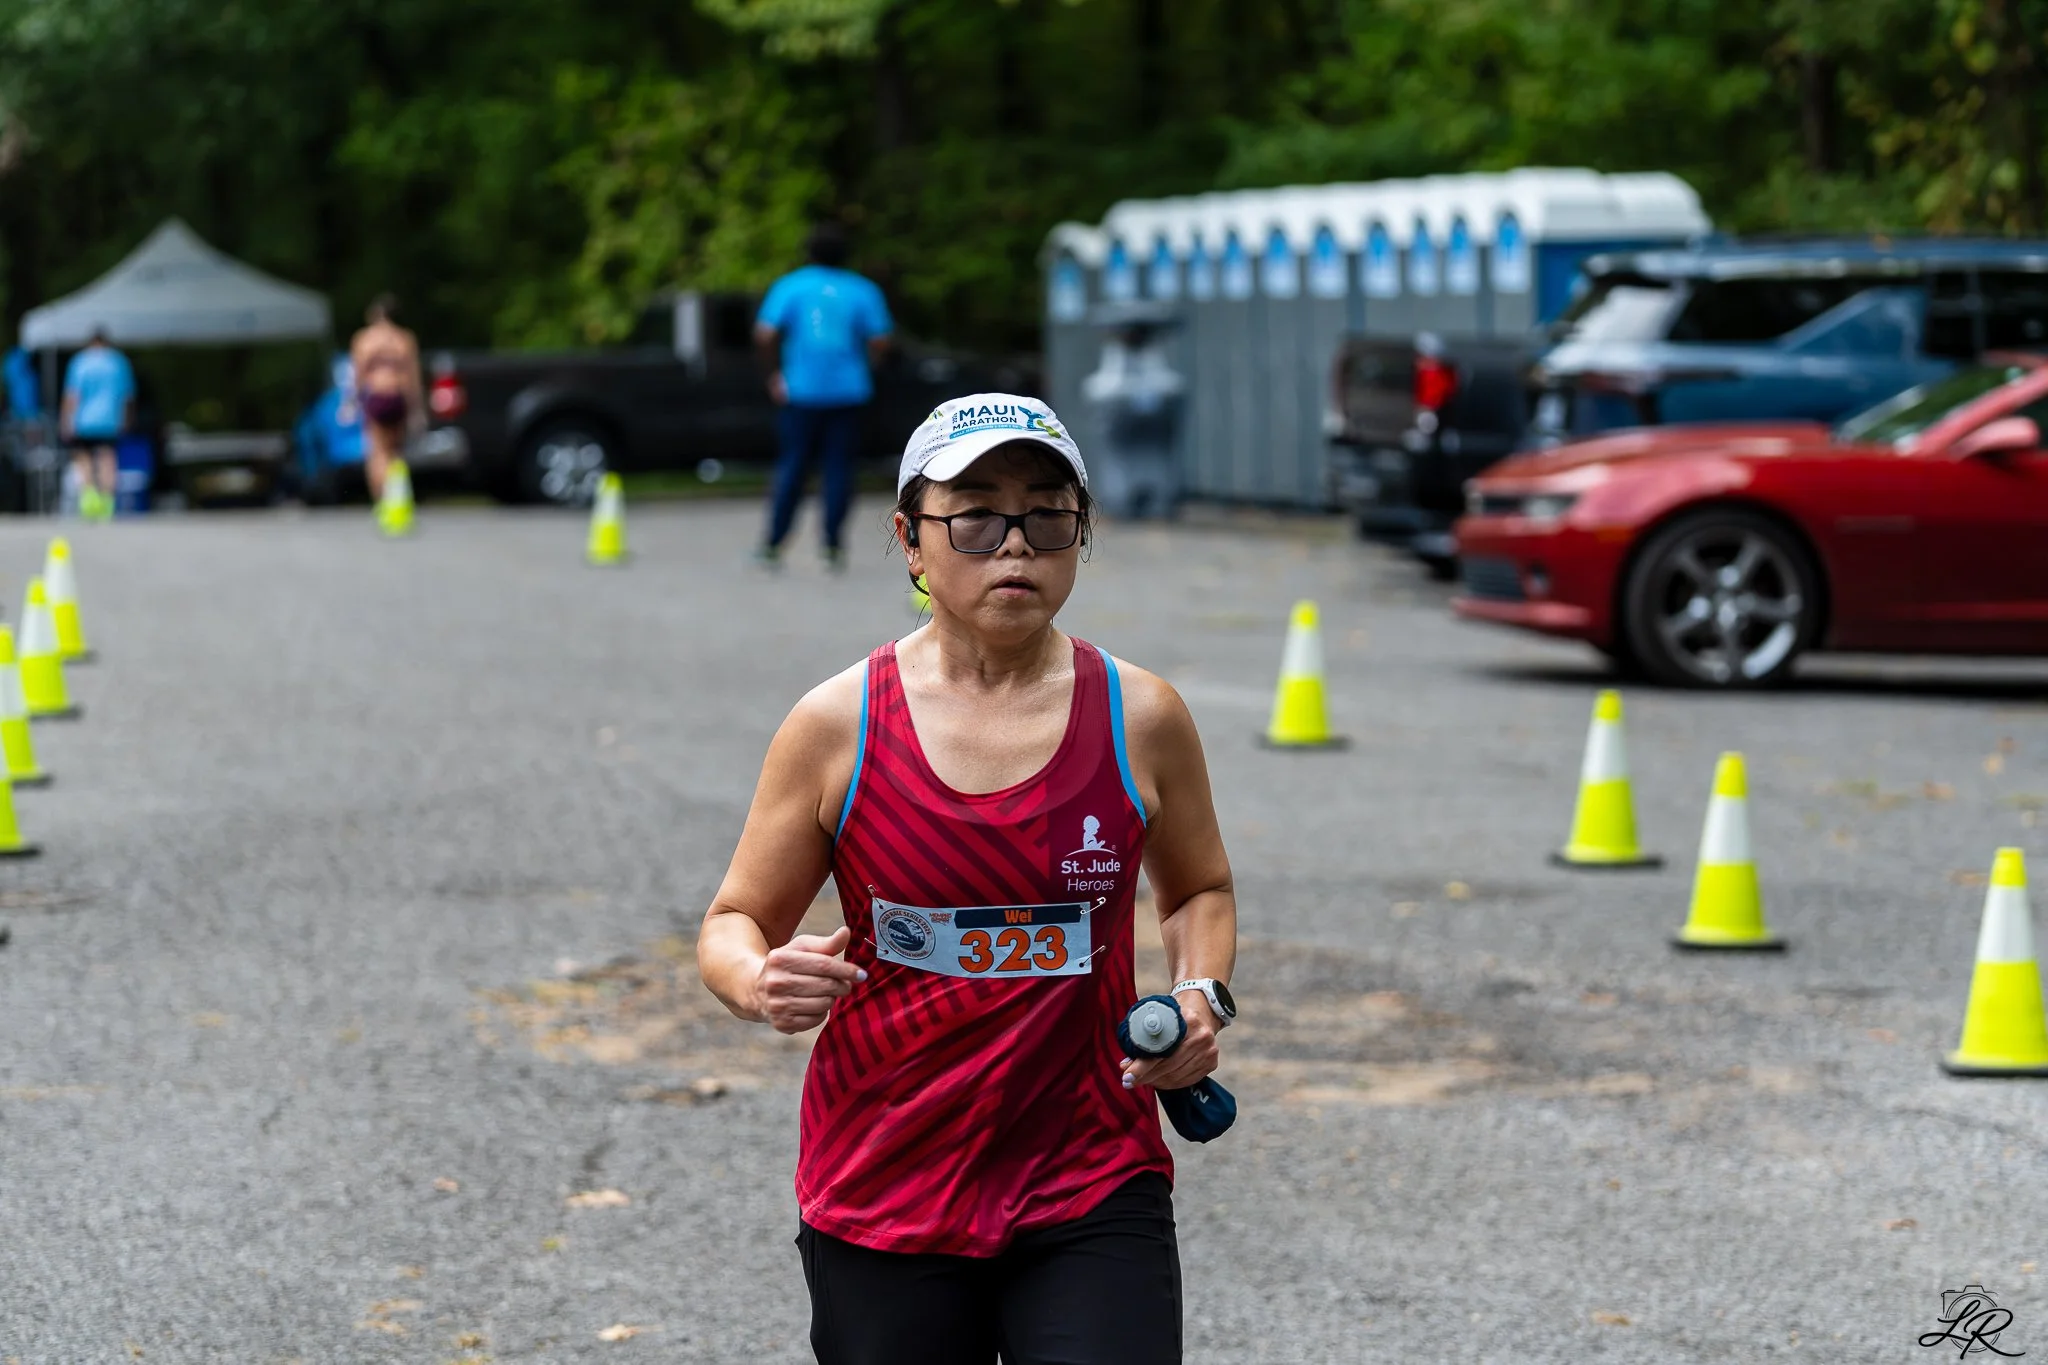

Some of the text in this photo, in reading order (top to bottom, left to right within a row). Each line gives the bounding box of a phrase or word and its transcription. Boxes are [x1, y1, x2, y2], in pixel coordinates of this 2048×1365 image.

[959, 405, 1015, 421] MAUI
[953, 416, 1017, 431] MARATHON
[1061, 858, 1120, 874] St. Jude
[1067, 878, 1115, 891] Heroes
[903, 911, 921, 923] SERIES
[1004, 909, 1033, 924] Wei
[958, 925, 1069, 973] 323
